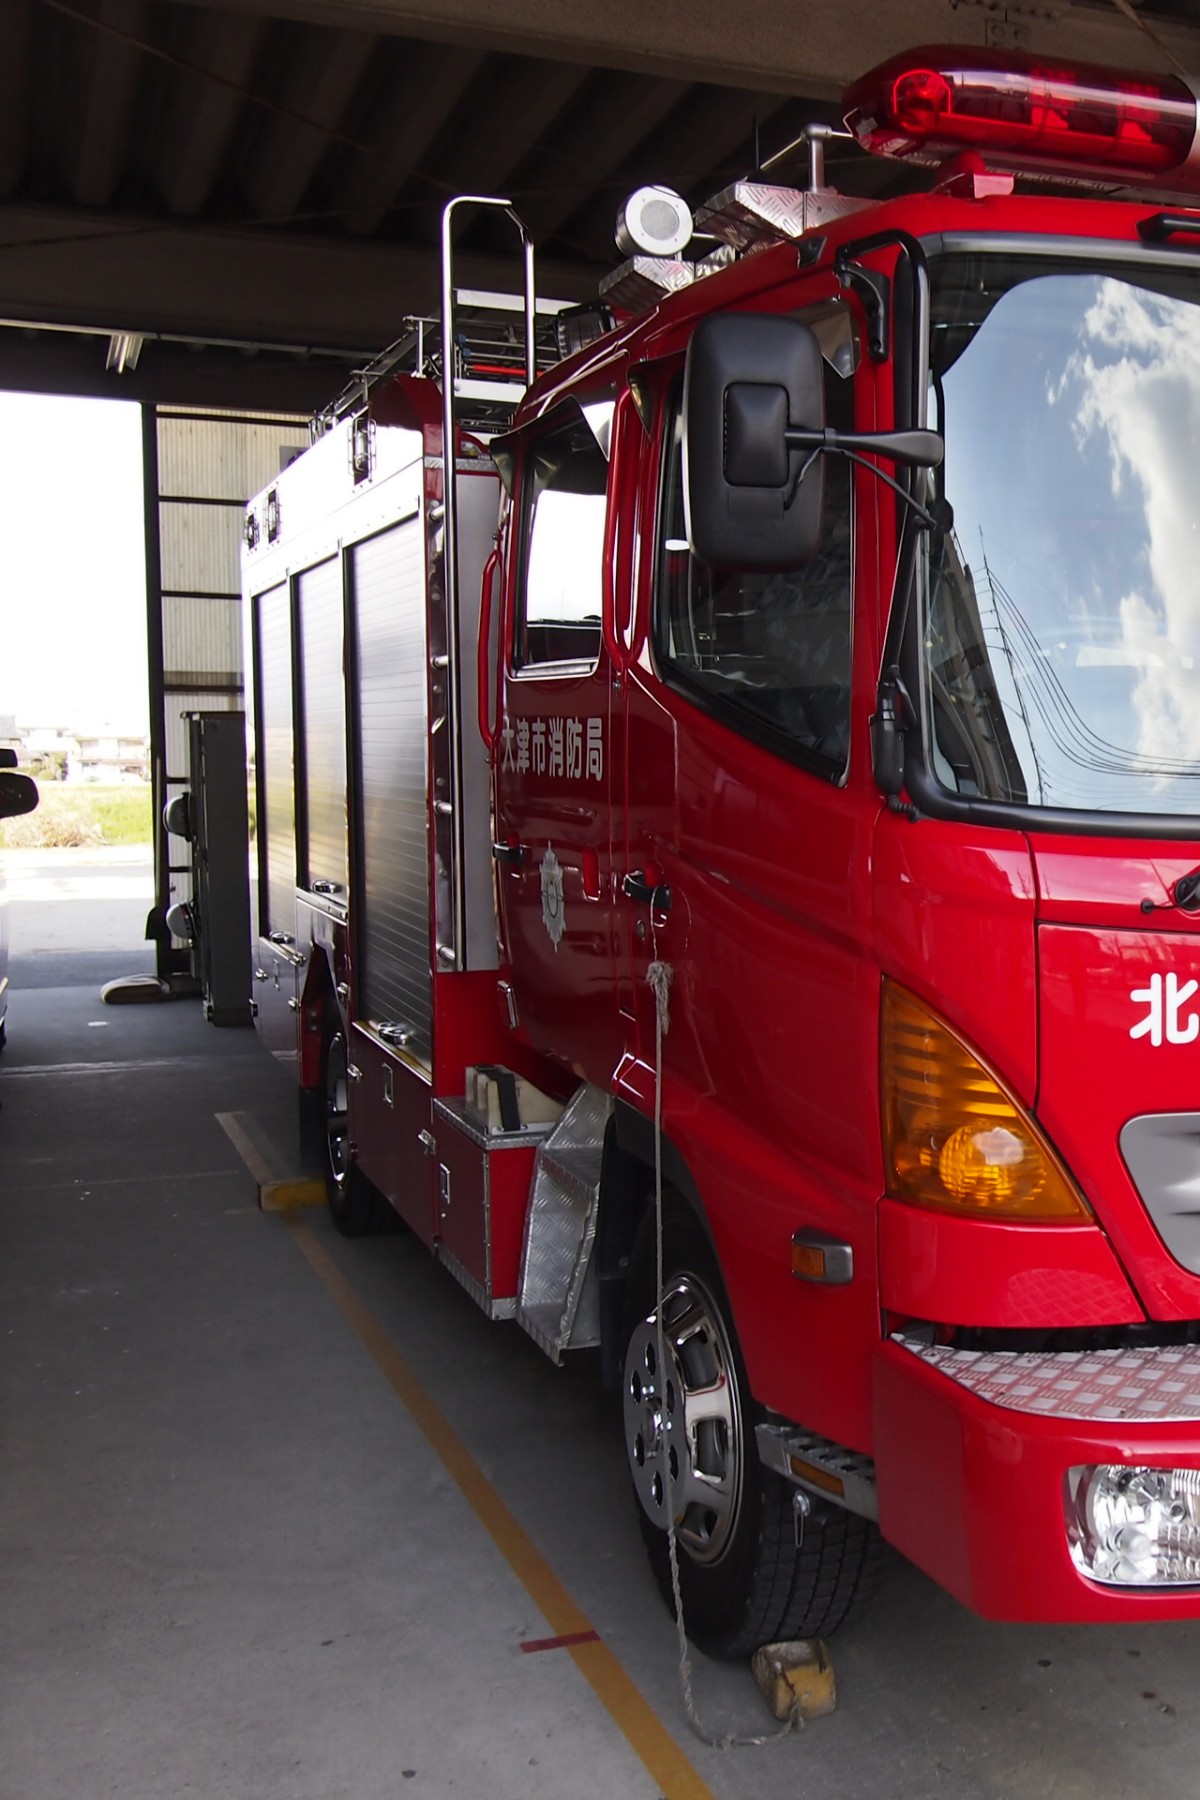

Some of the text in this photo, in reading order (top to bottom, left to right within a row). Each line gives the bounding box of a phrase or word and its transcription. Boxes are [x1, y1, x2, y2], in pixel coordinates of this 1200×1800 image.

[502, 715, 603, 782] 大津市消防局
